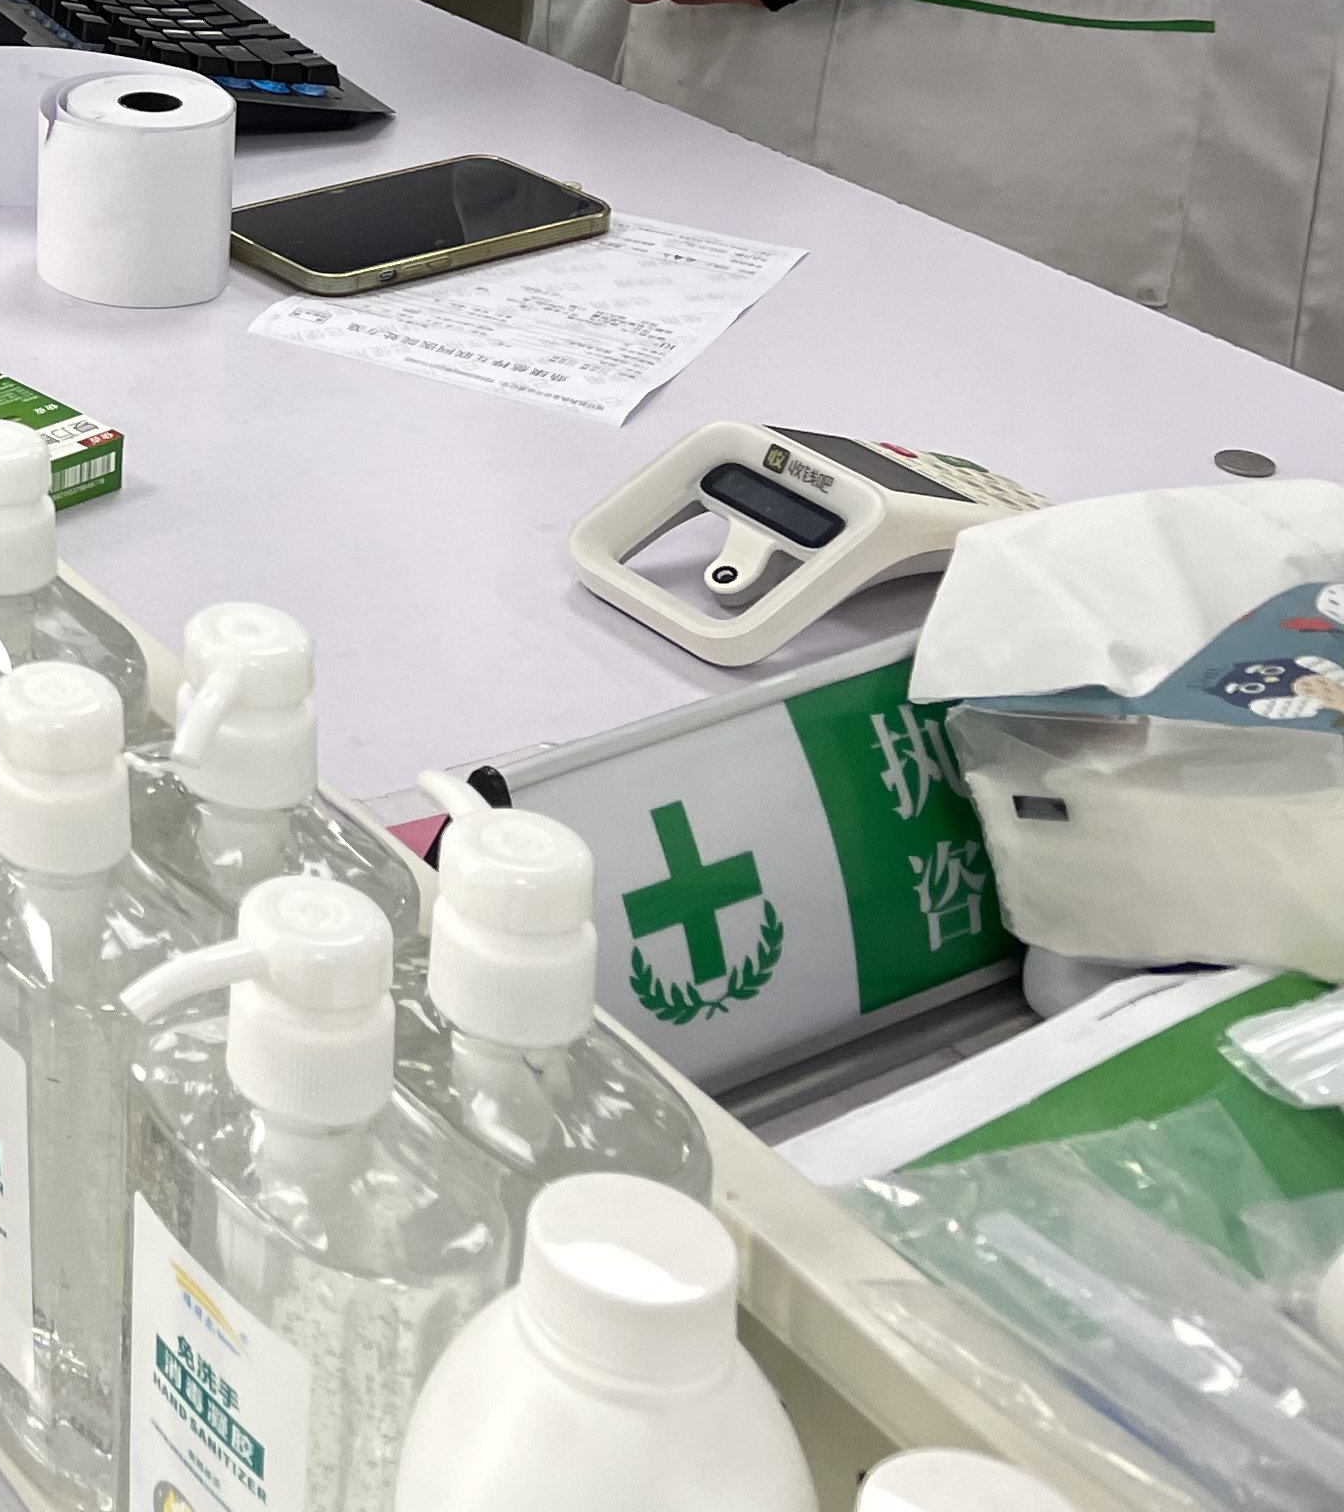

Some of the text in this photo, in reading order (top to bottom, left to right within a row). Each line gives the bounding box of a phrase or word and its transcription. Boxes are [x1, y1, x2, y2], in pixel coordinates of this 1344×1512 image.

[788, 459, 835, 494] 收钱吧
[909, 839, 988, 953] 咨
[178, 1335, 241, 1412] 免洗手
[153, 1371, 187, 1426] HAND
[189, 1416, 268, 1504] SANITIZER
